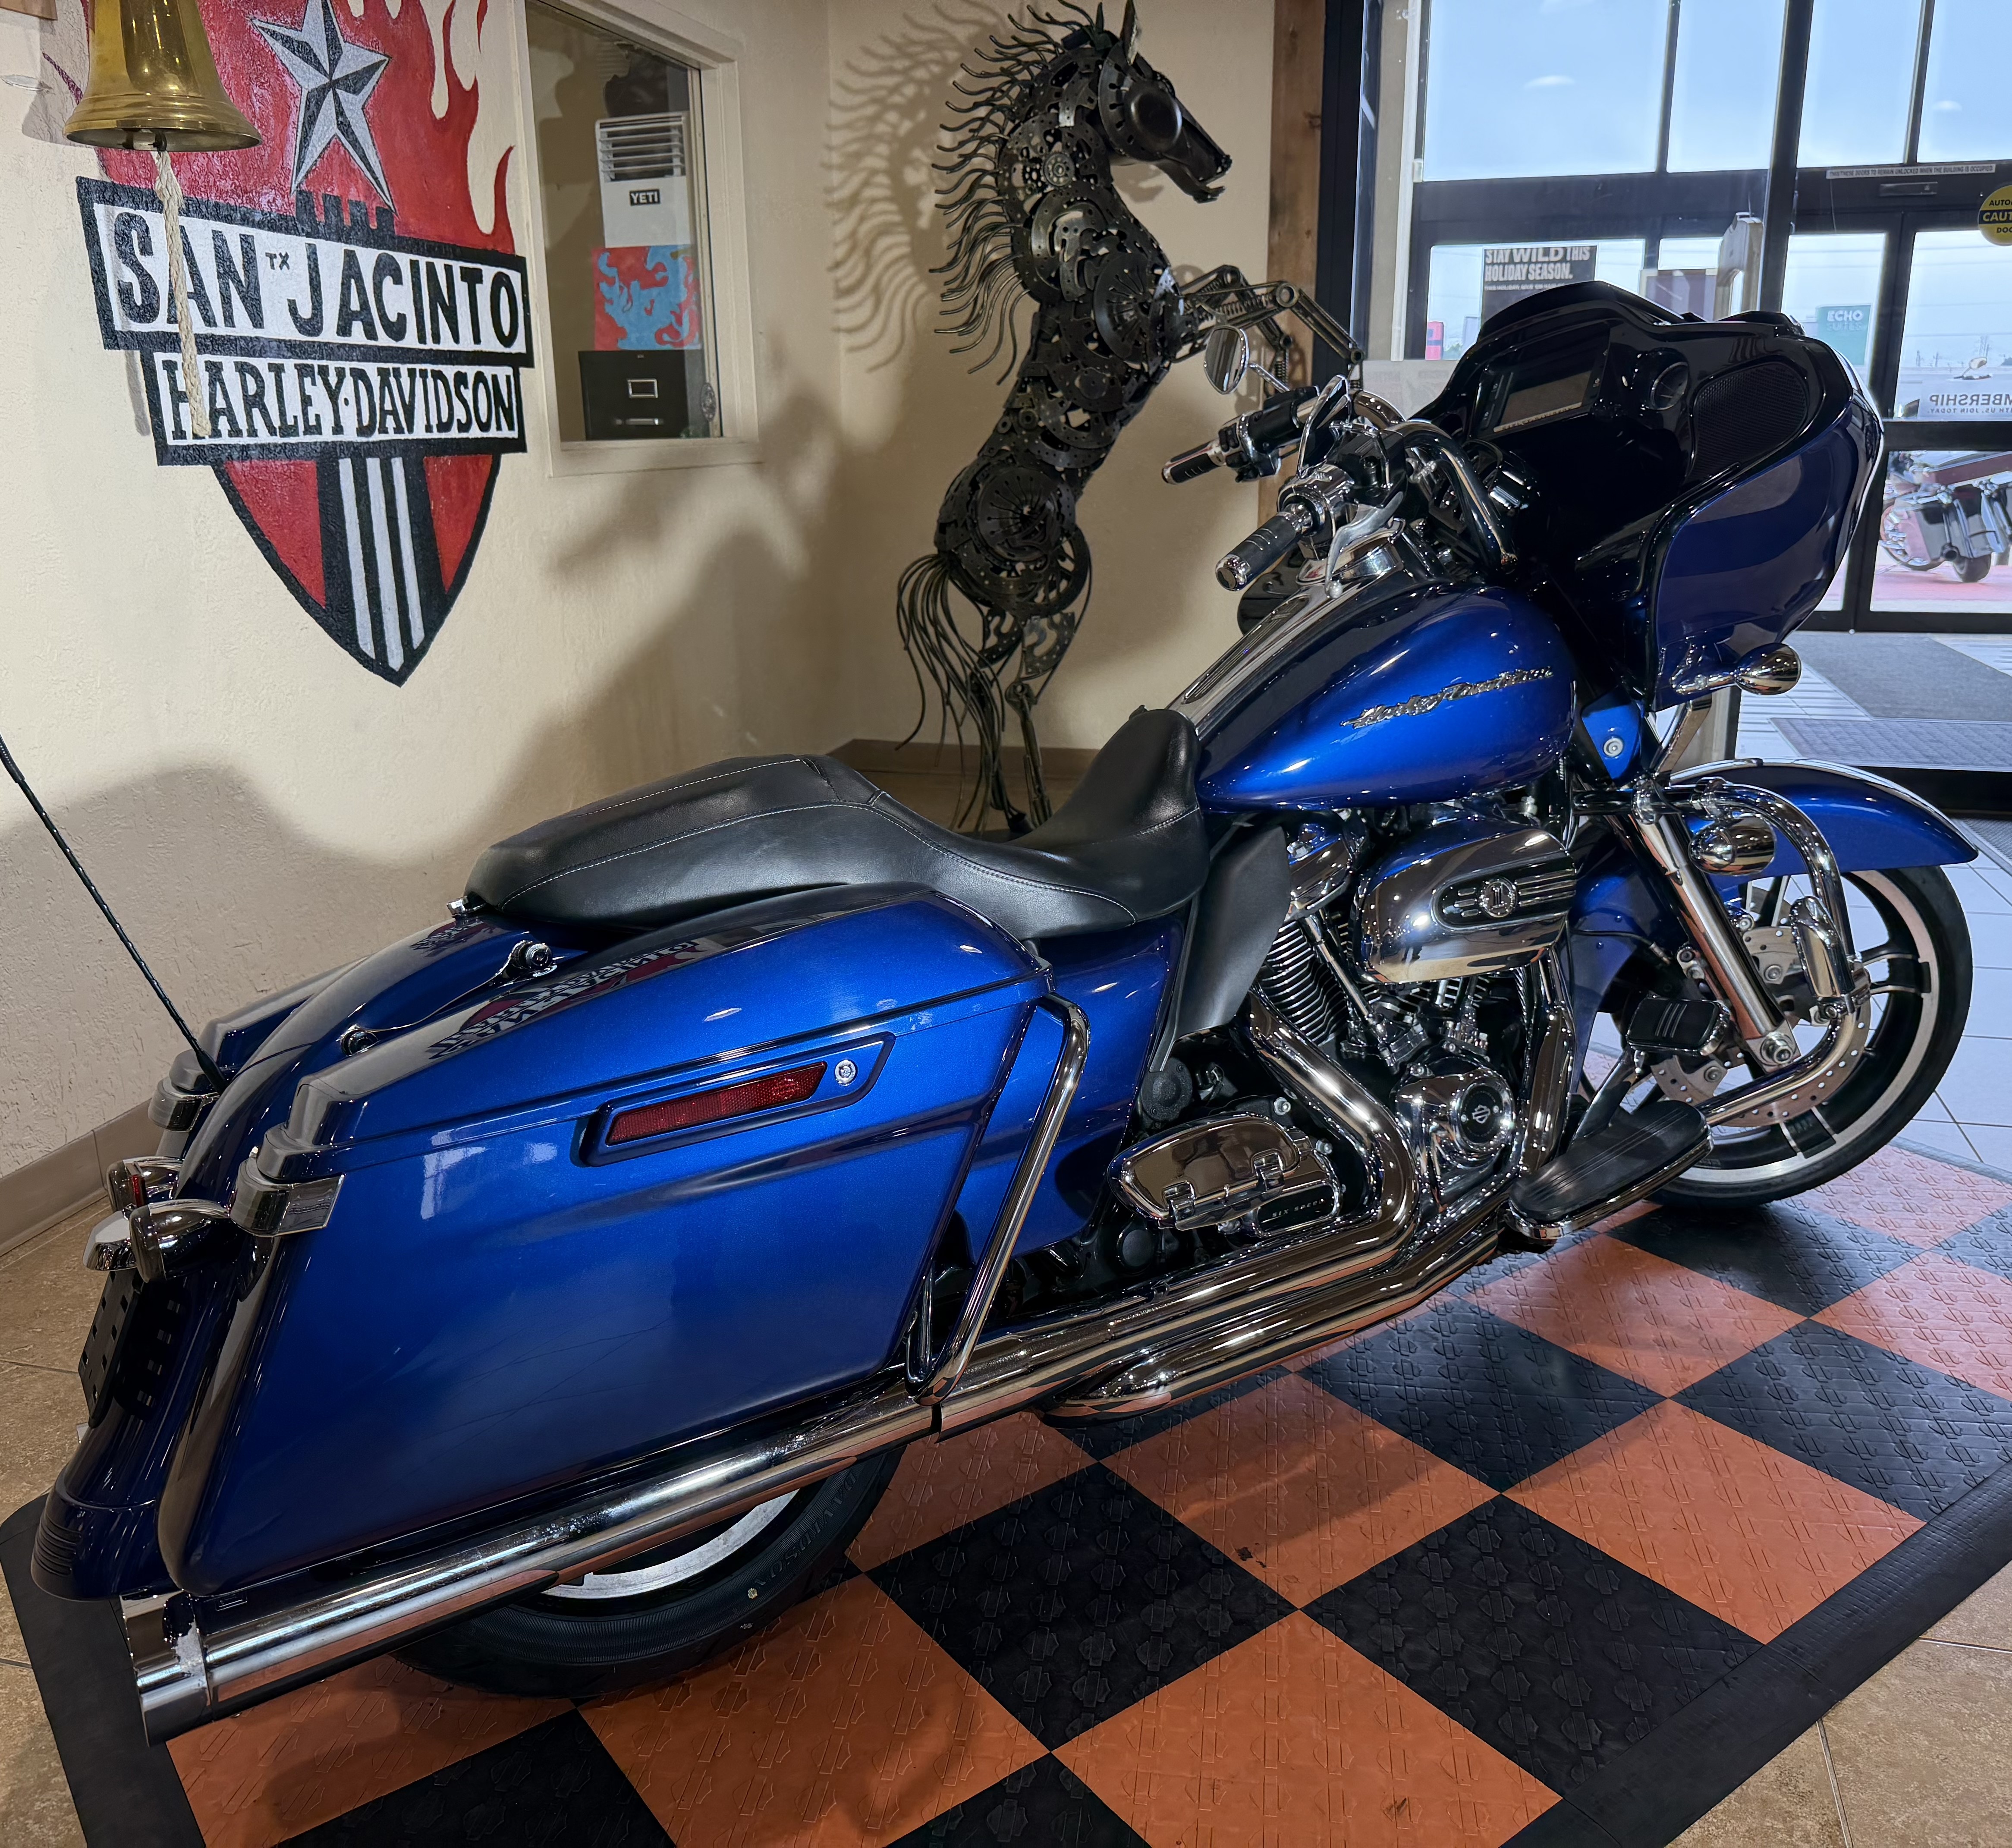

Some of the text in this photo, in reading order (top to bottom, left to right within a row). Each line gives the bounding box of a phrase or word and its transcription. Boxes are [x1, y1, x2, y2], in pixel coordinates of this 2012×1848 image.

[630, 191, 658, 204] YETI
[1486, 246, 1590, 263] STAY WILD THIS
[1484, 262, 1574, 281] HOLIDAY SEASON.
[114, 212, 519, 348] SAN TX JACINTO
[1827, 310, 1863, 321] ECHO
[1272, 1209, 1289, 1218] SIX
